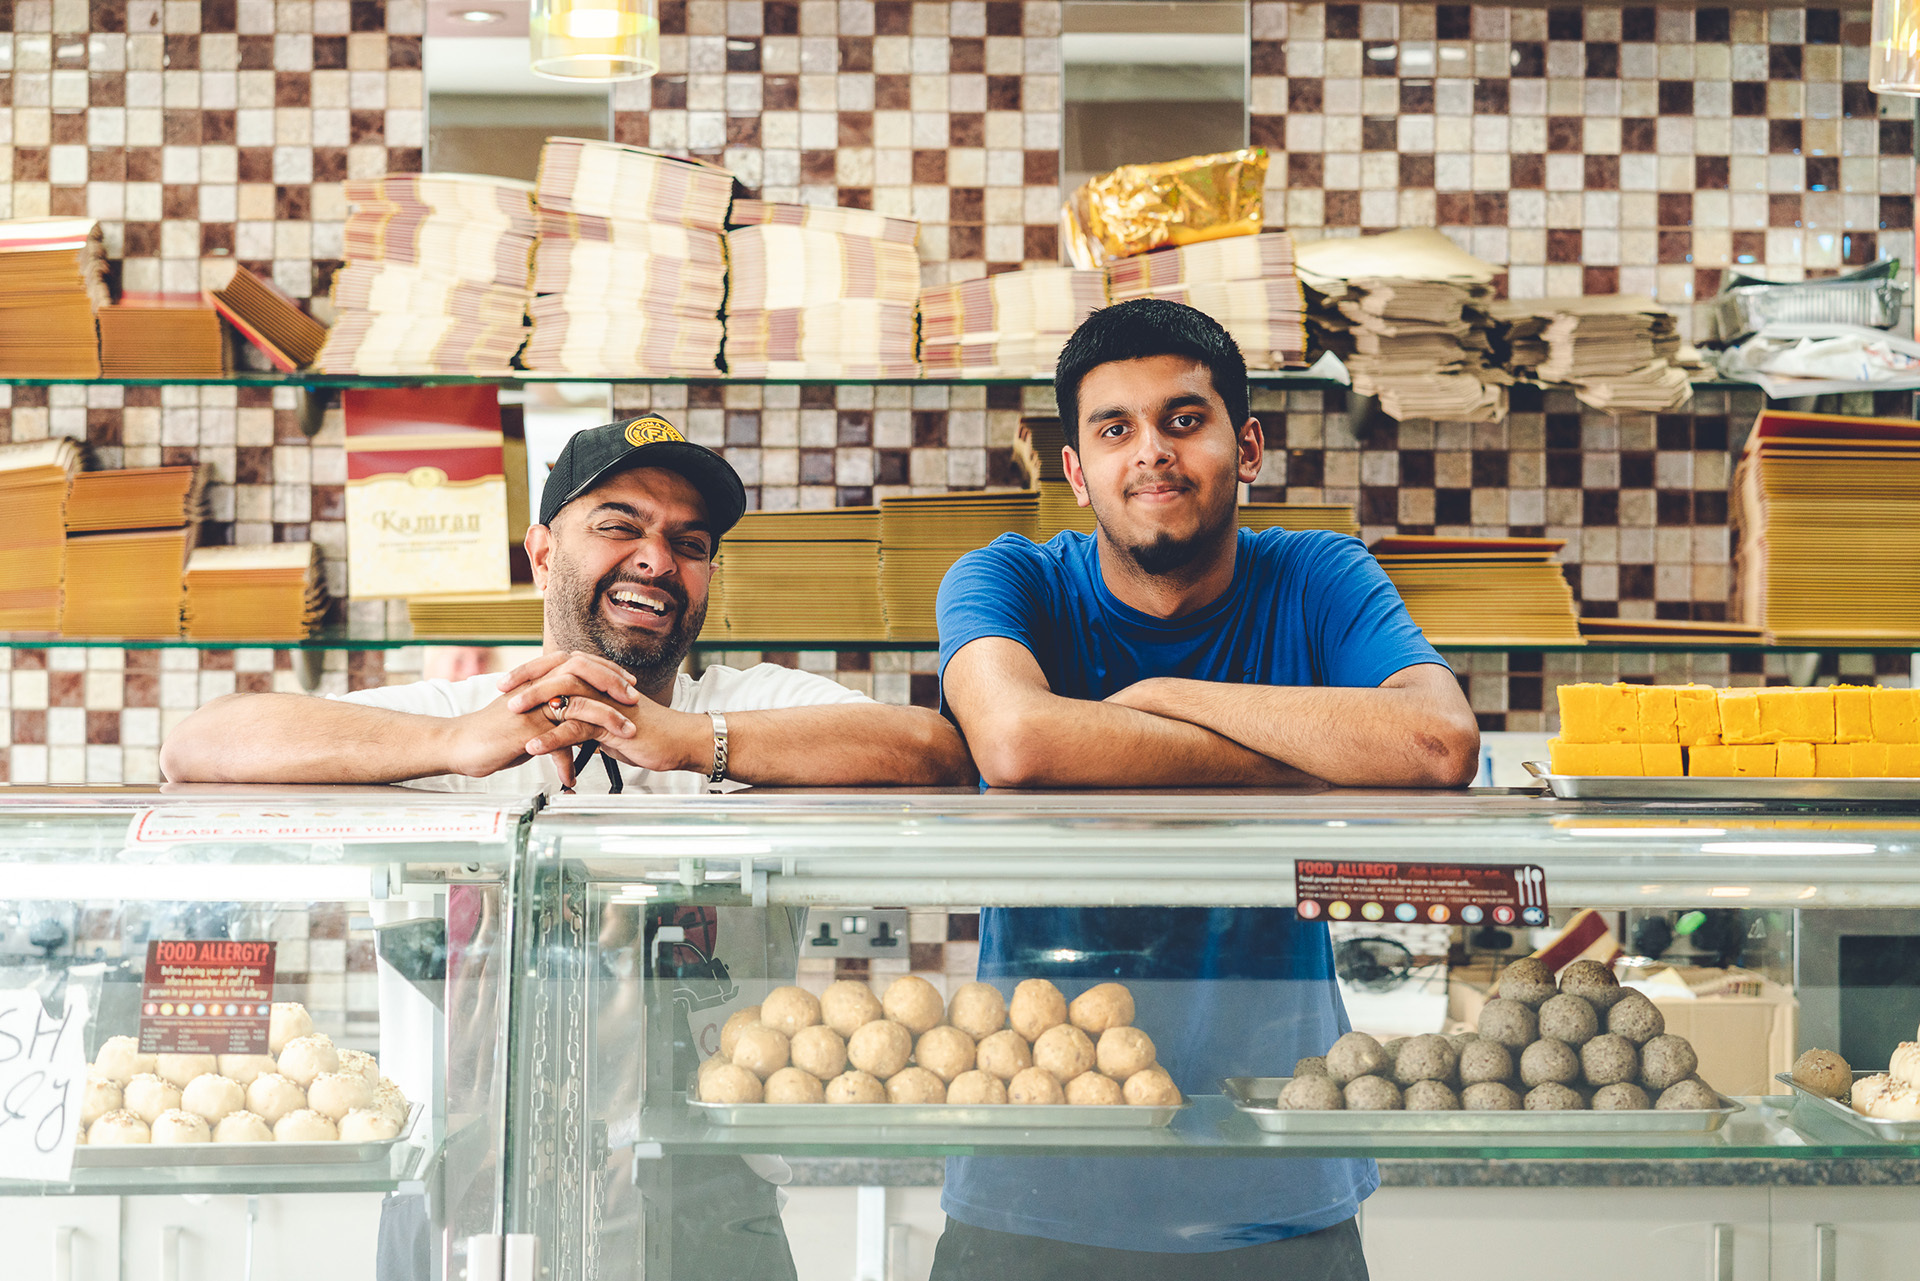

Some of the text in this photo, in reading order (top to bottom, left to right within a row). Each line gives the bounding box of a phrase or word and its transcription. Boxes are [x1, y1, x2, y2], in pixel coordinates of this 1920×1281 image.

[371, 510, 480, 537] Kamran
[147, 828, 224, 836] PLEASE
[231, 827, 270, 835] ASK
[278, 826, 357, 834] BEFORE
[1298, 861, 1398, 876] FOOD ALLERGY?
[156, 942, 270, 963] FOOD ALLERGY?
[161, 965, 260, 978] Before placing your order please
[187, 978, 192, 986] a
[192, 976, 219, 986] member
[220, 976, 227, 986] of
[228, 976, 242, 986] staff
[243, 976, 249, 986] if
[249, 979, 255, 987] a
[149, 987, 268, 1000] person in your party has a food allergy
[0, 1004, 73, 1062] SH
